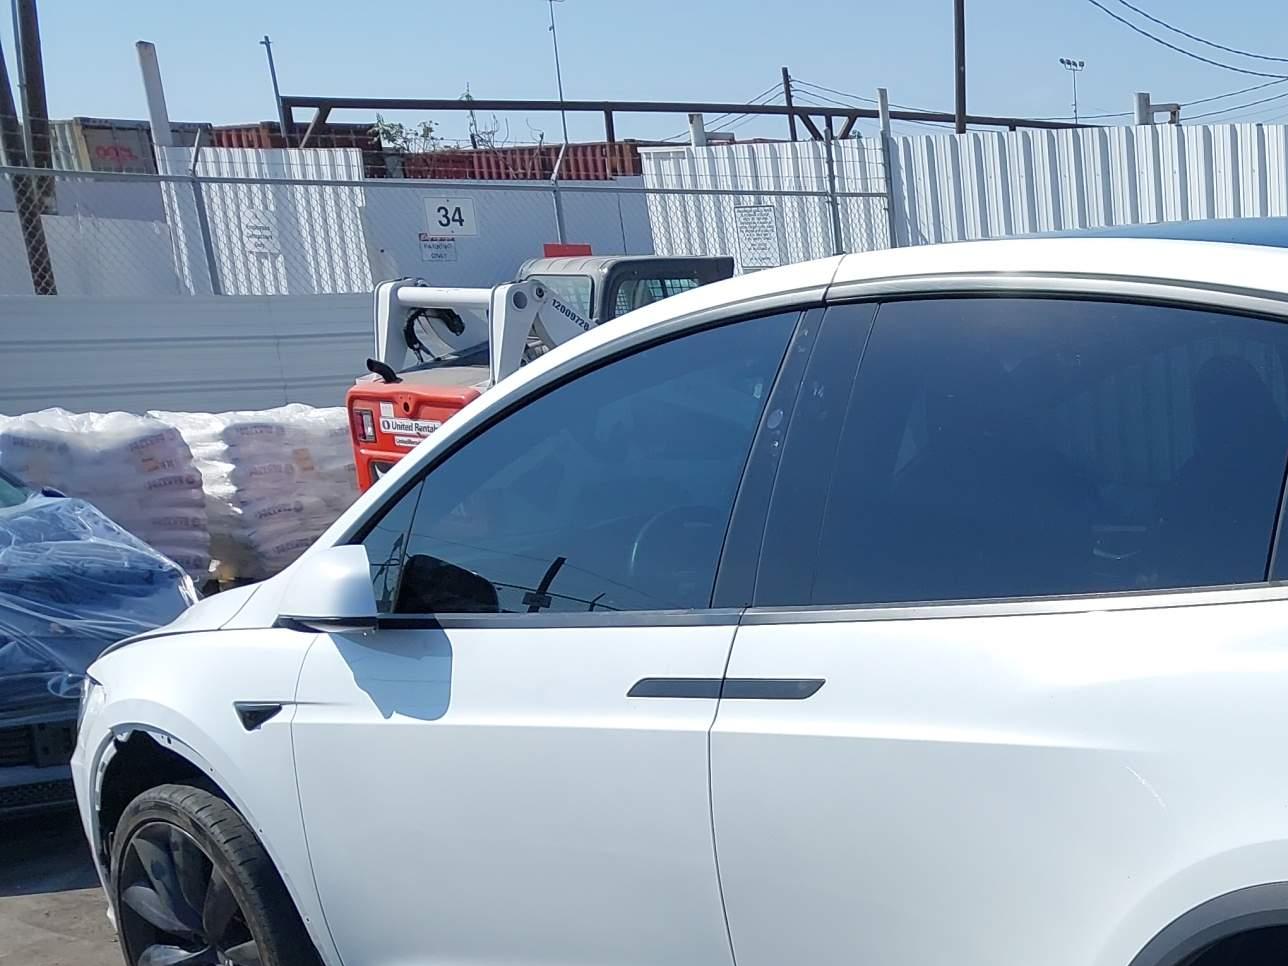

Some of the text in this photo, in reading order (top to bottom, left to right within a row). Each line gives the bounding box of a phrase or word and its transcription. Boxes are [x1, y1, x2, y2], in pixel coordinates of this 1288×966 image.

[437, 206, 464, 227] 34
[552, 299, 590, 331] 12009728
[391, 421, 414, 431] United
